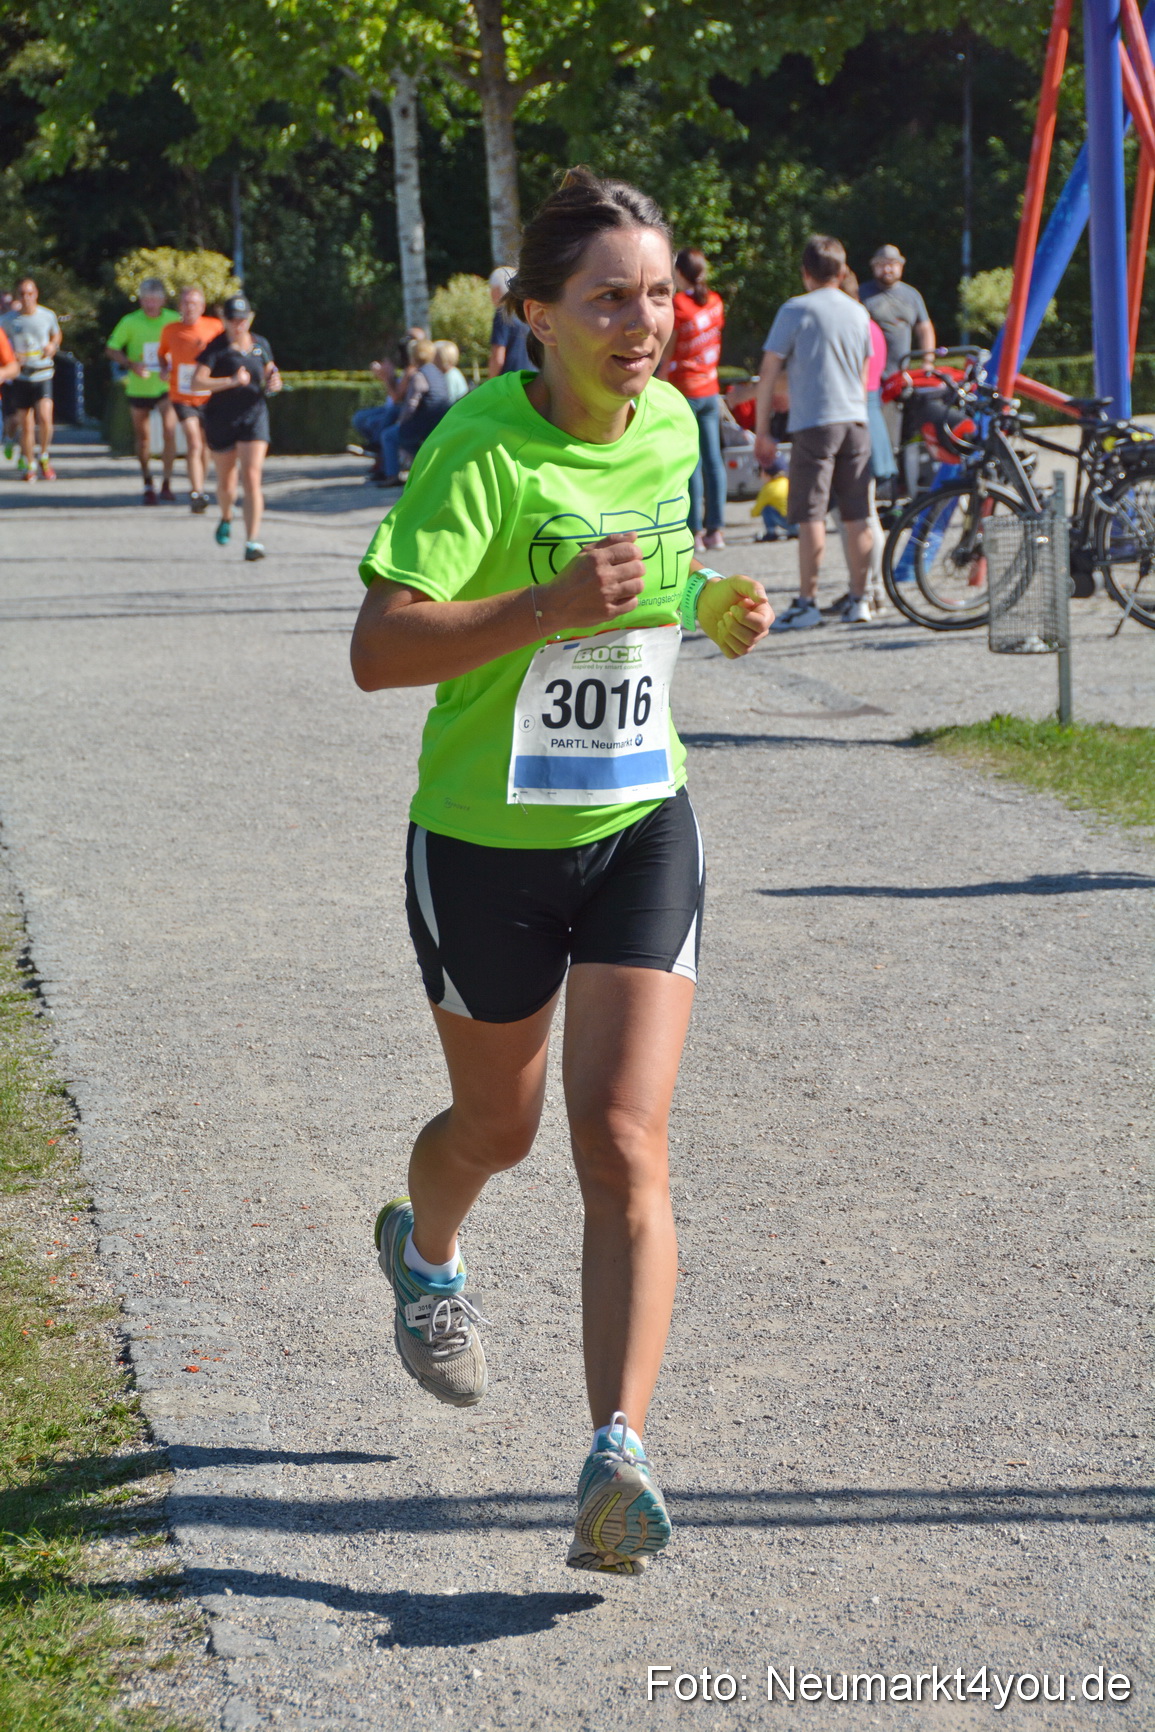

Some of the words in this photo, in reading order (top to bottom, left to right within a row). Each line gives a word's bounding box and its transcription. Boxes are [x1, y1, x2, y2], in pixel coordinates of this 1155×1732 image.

[573, 644, 643, 663] BOCK
[541, 675, 653, 730] 3016
[550, 738, 589, 749] PARTL
[591, 738, 633, 750] Neumarkt
